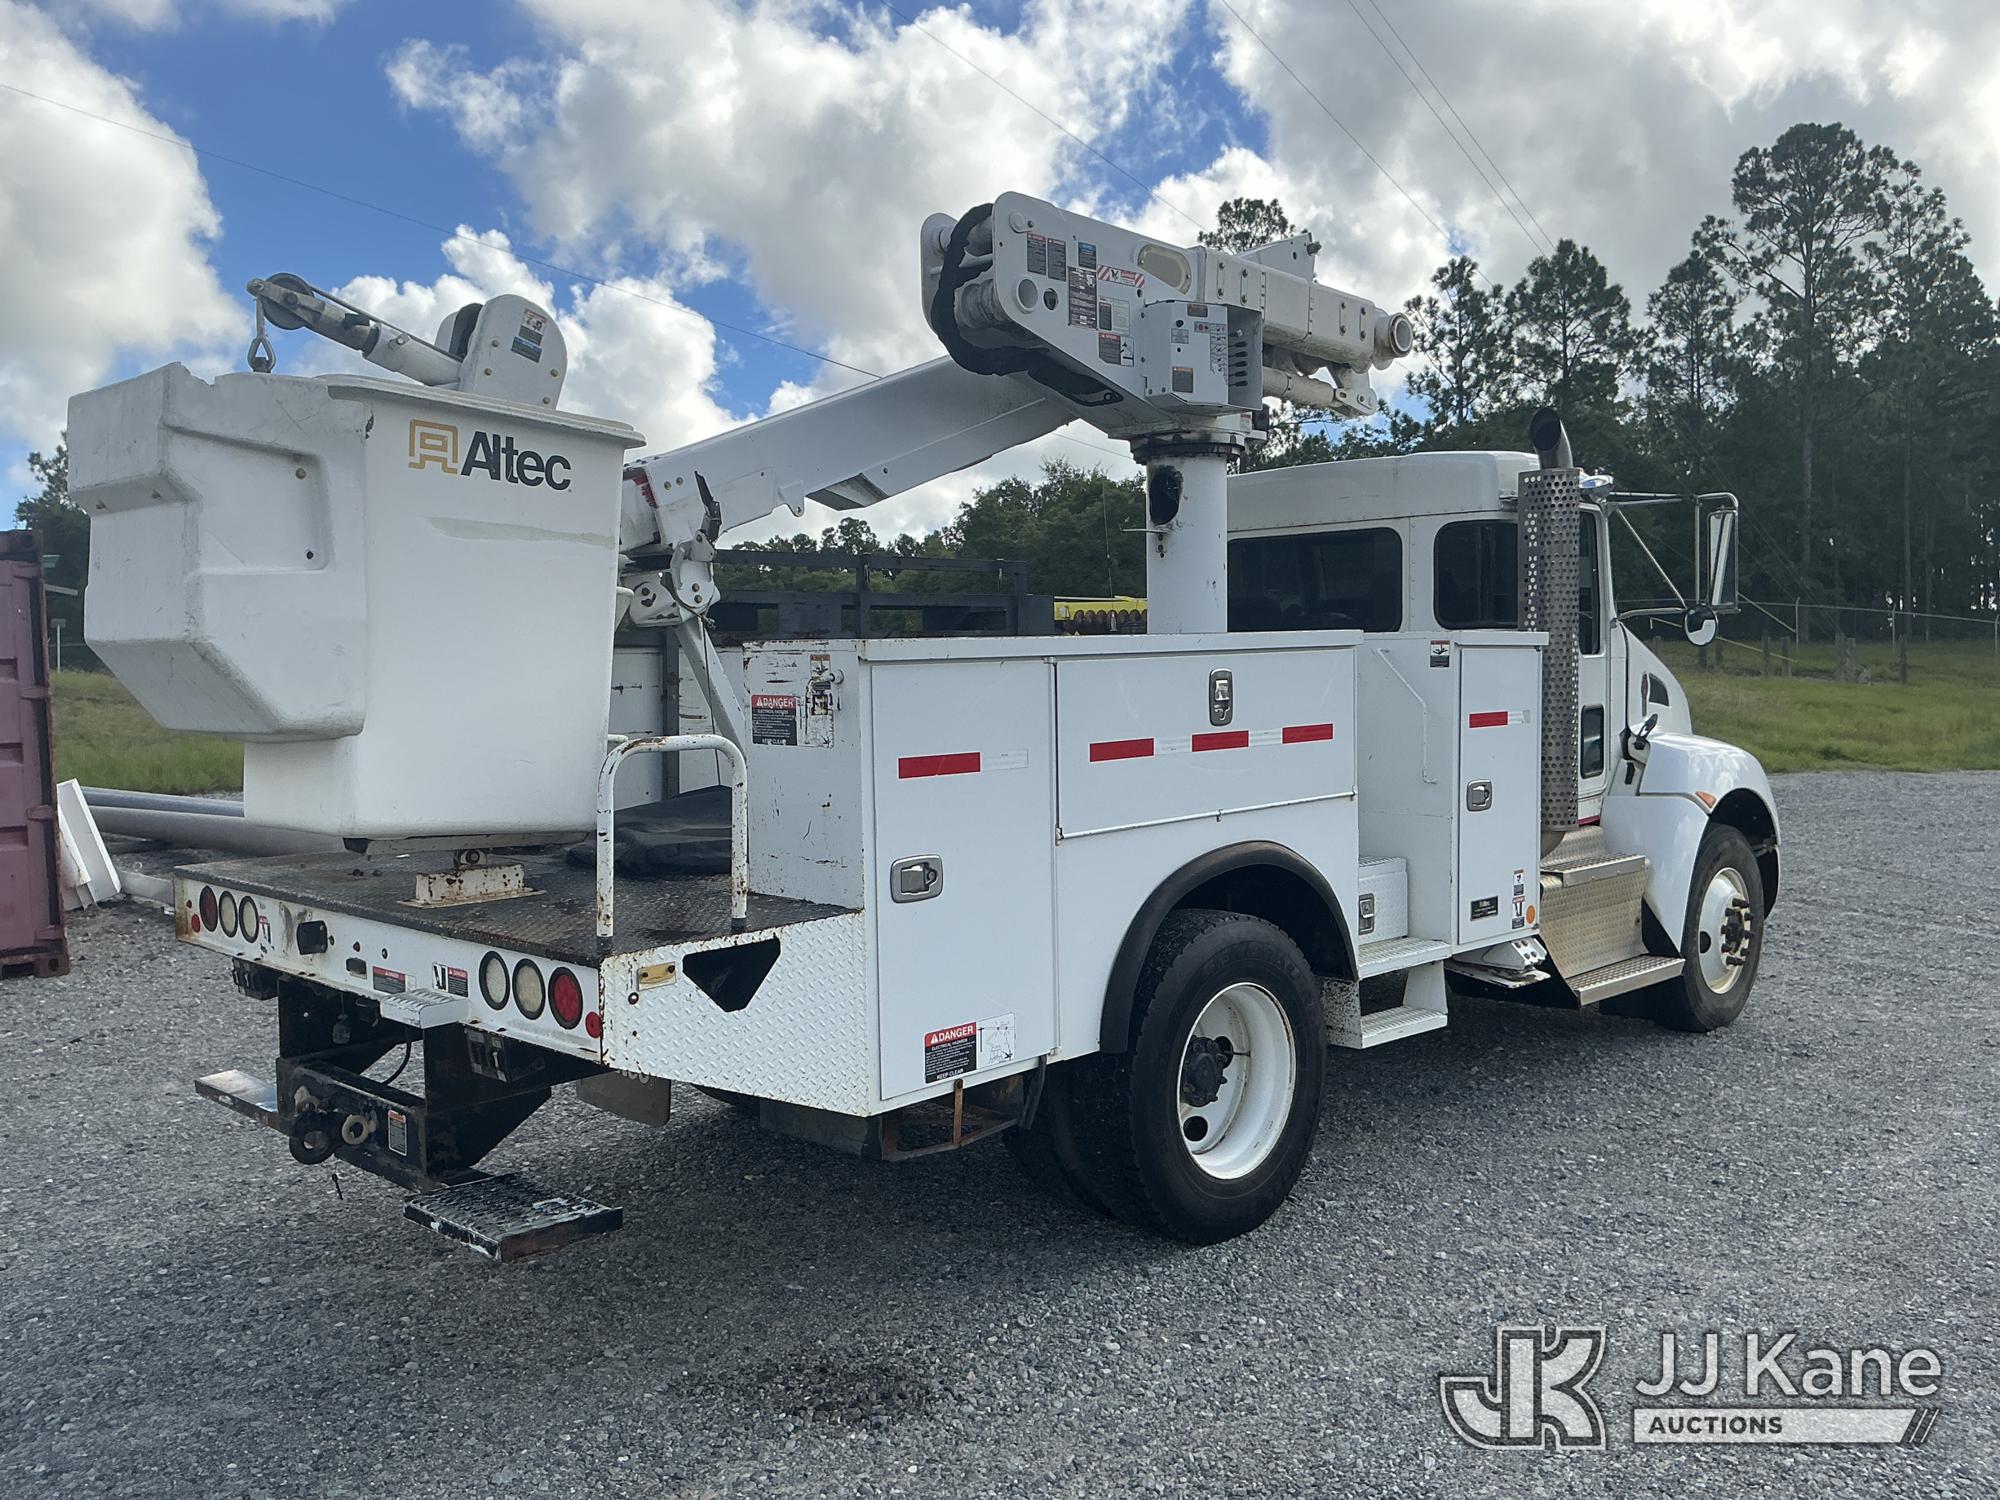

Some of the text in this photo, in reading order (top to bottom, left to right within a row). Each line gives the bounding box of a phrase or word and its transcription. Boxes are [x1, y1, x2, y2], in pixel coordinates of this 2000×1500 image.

[460, 430, 572, 491] Altec
[762, 696, 794, 708] DANGER
[938, 1025, 974, 1042] DANGER
[936, 1068, 964, 1080] KEEP CLEAR
